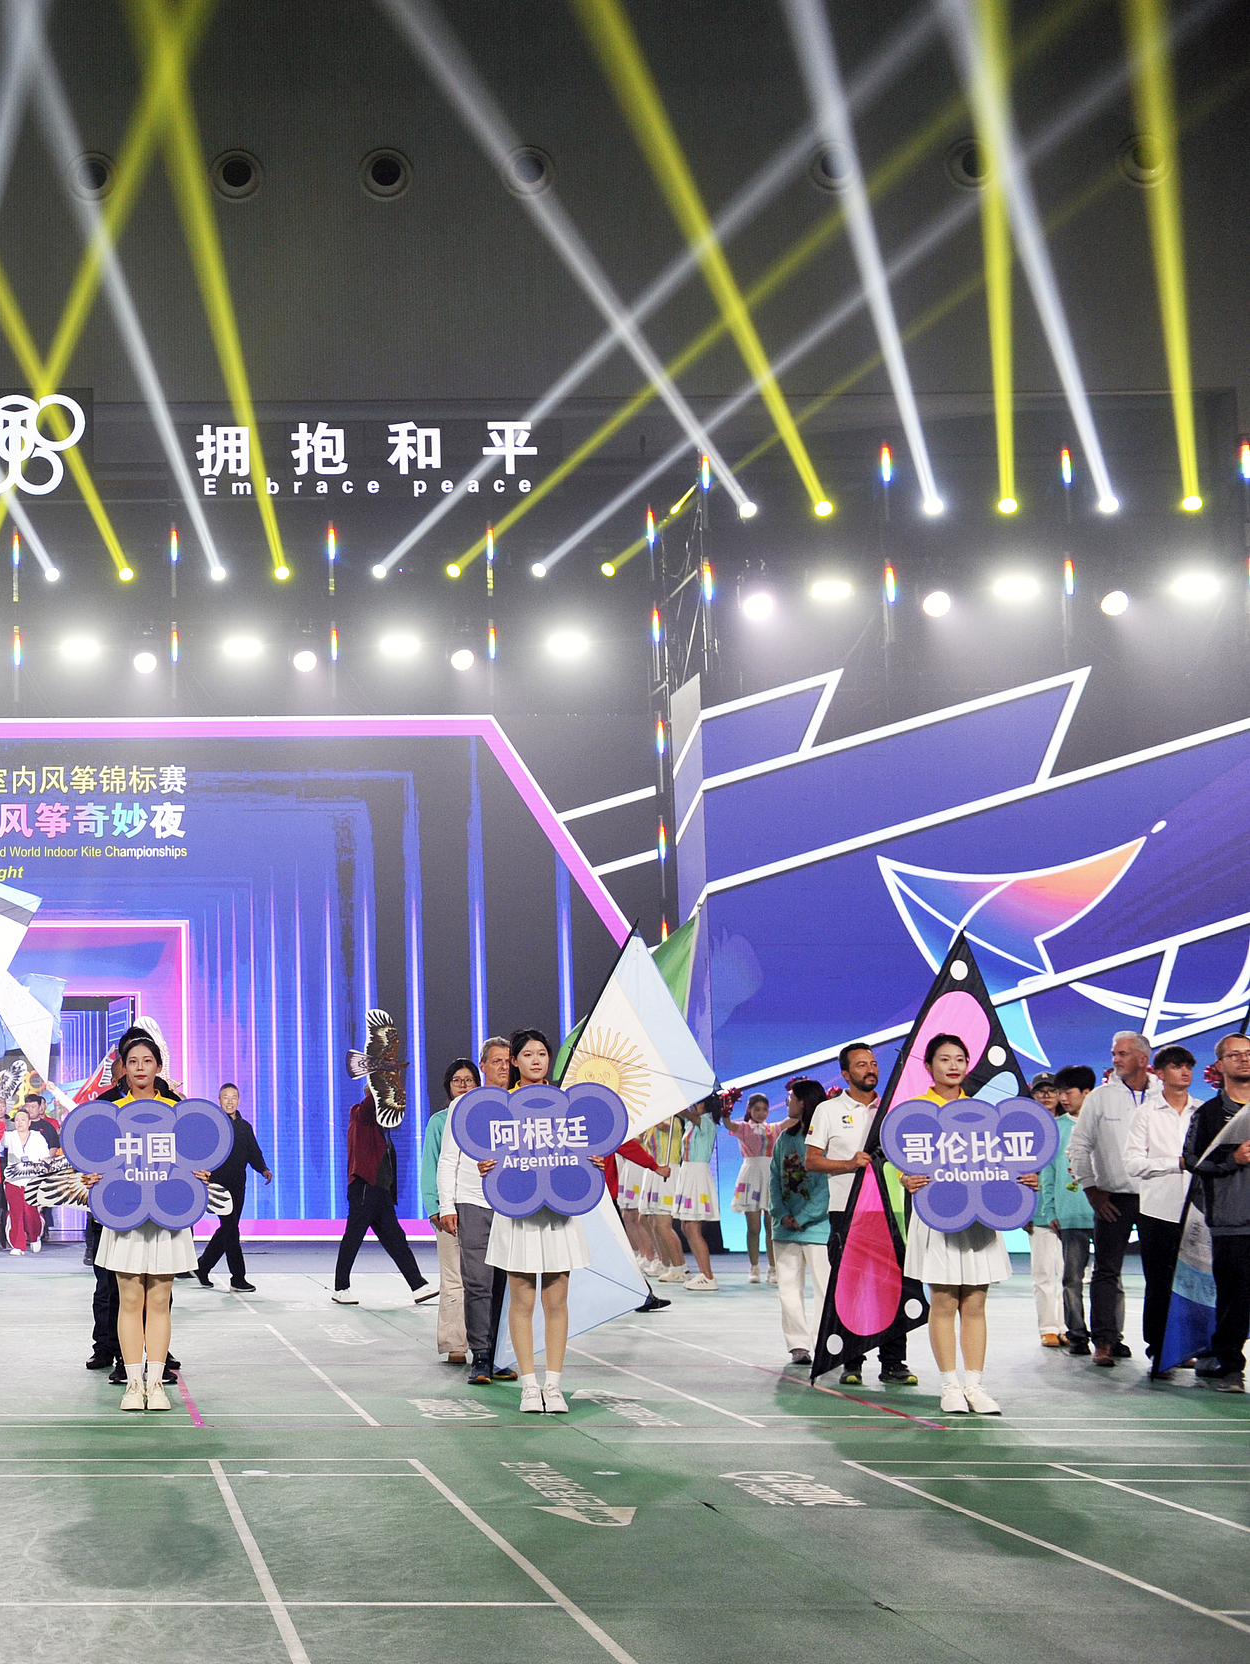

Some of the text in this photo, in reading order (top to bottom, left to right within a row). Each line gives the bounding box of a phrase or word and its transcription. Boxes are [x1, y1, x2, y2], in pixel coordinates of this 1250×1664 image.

[195, 421, 538, 477] 拥抱和平
[203, 477, 532, 498] Embrace peace
[9, 845, 41, 858] World
[44, 845, 78, 858] Indoor
[81, 845, 102, 858] Kite
[105, 845, 187, 860] Championships
[489, 1115, 589, 1151] 阿根廷
[114, 1132, 176, 1164] 中国
[902, 1131, 1037, 1165] 哥伦比亚
[502, 1152, 579, 1171] Argentina
[124, 1167, 168, 1181] China
[934, 1166, 1009, 1182] Colombia
